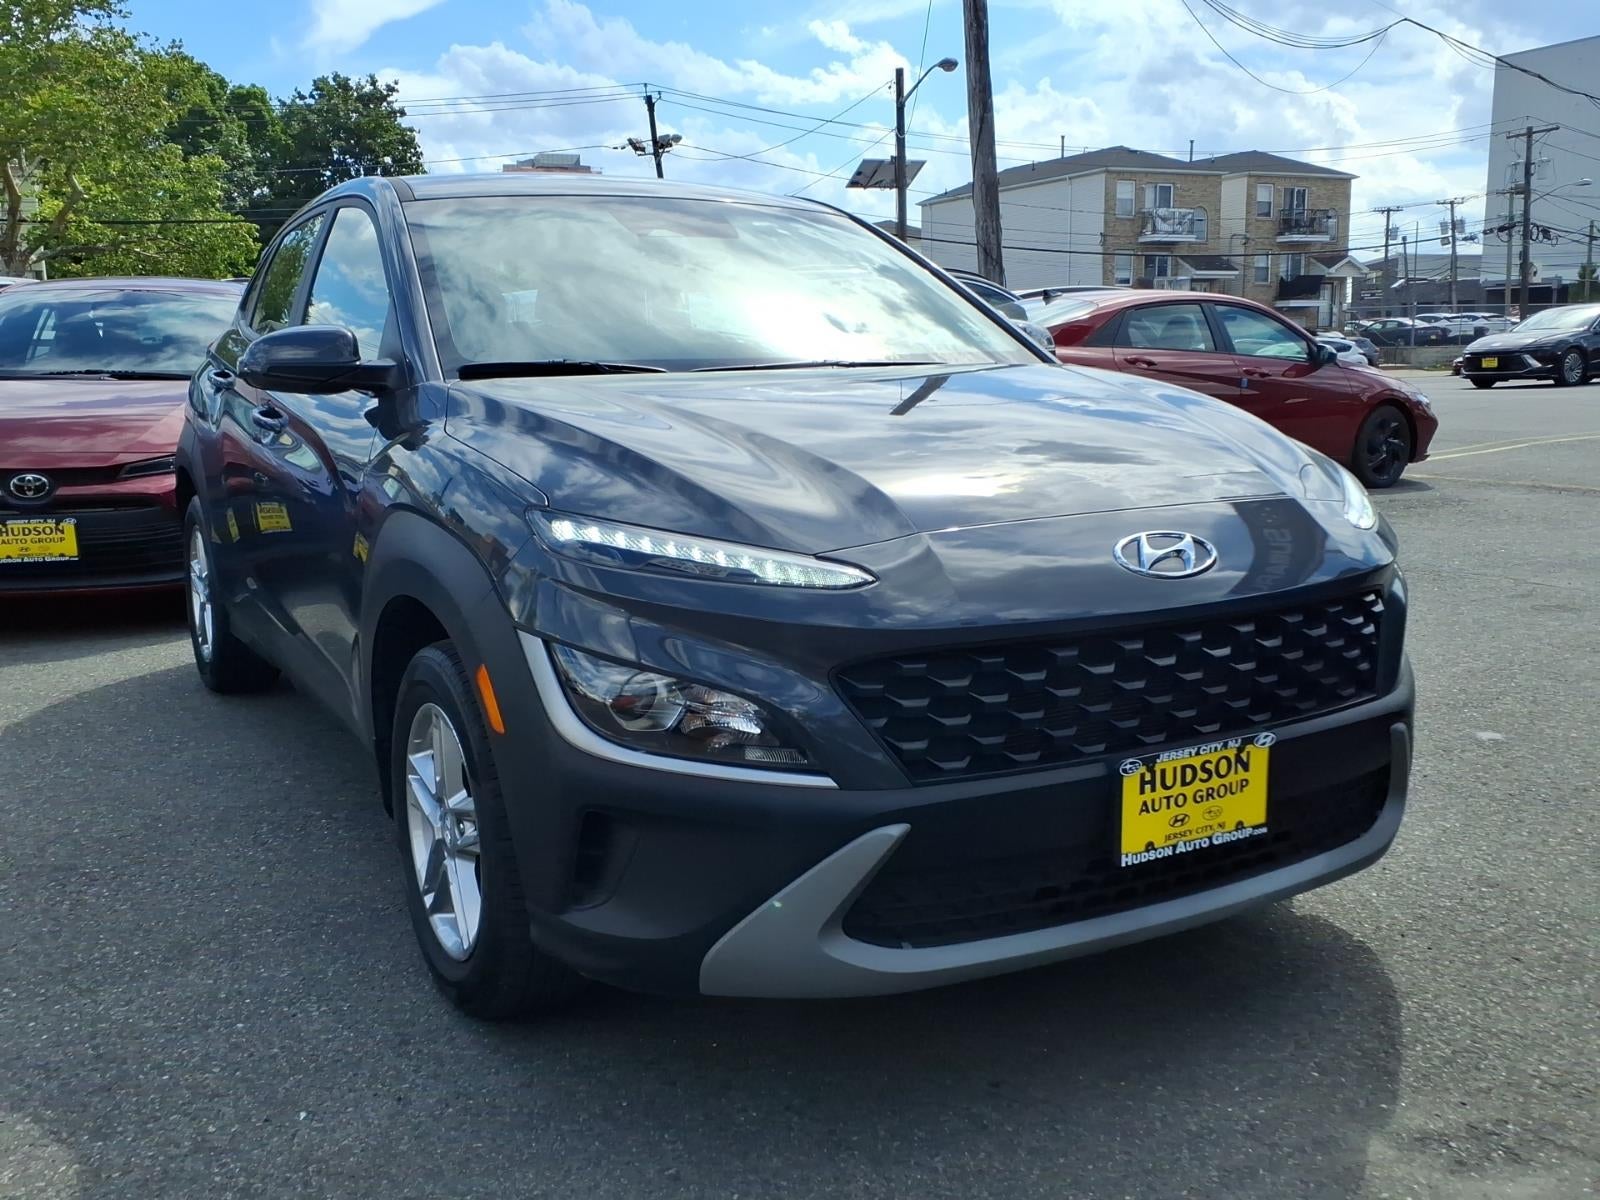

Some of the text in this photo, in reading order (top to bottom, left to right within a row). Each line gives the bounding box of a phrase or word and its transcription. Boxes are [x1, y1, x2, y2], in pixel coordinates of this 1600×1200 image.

[0, 525, 65, 537] HUDSON
[31, 536, 66, 544] GROUP
[1157, 748, 1197, 763] JERSEY
[1227, 738, 1242, 749] NJ
[1139, 750, 1250, 795] HUDSON
[1138, 778, 1249, 816] AUTO GROUP
[1164, 829, 1193, 843] JERSEY
[1121, 846, 1173, 867] HUDSON
[1175, 839, 1210, 854] AUTO
